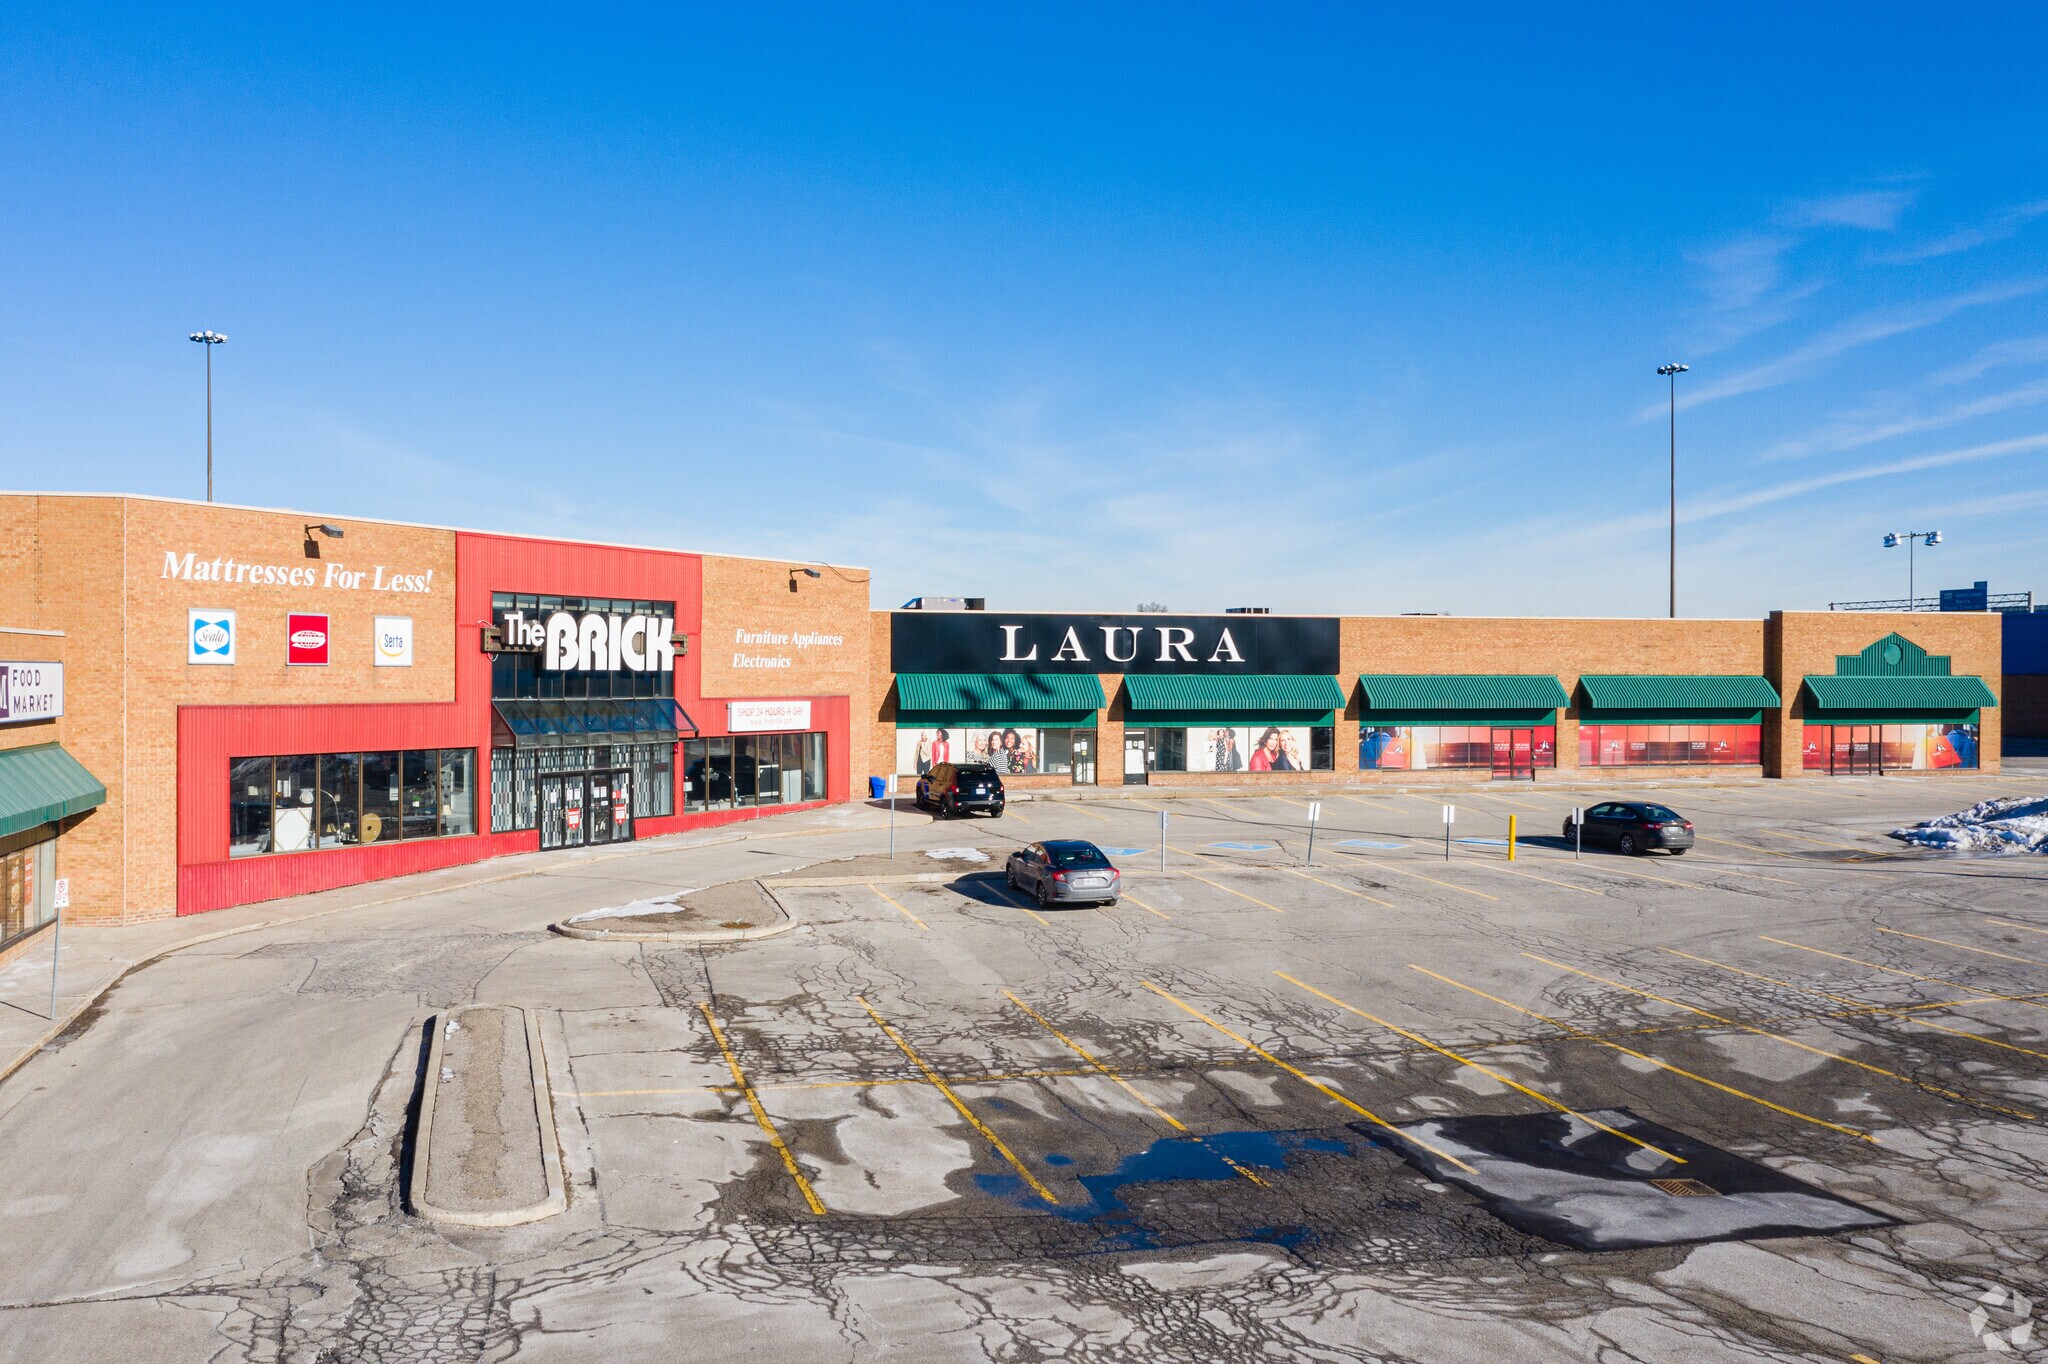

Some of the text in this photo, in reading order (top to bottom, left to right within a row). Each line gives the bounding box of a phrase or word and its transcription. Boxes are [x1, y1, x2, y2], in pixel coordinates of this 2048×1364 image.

[161, 551, 433, 594] Mattresses For Less!
[199, 629, 225, 646] Sealy
[504, 611, 545, 646] The
[735, 628, 843, 649] Furniture Appliances
[384, 633, 403, 648] Serta
[546, 612, 675, 671] BRICK
[1000, 625, 1246, 662] LAURA
[733, 653, 791, 668] Electronics
[13, 669, 41, 687] FOOD
[14, 693, 53, 714] MARKET
[738, 706, 804, 717] SHOP 24 HOURS A DAY
